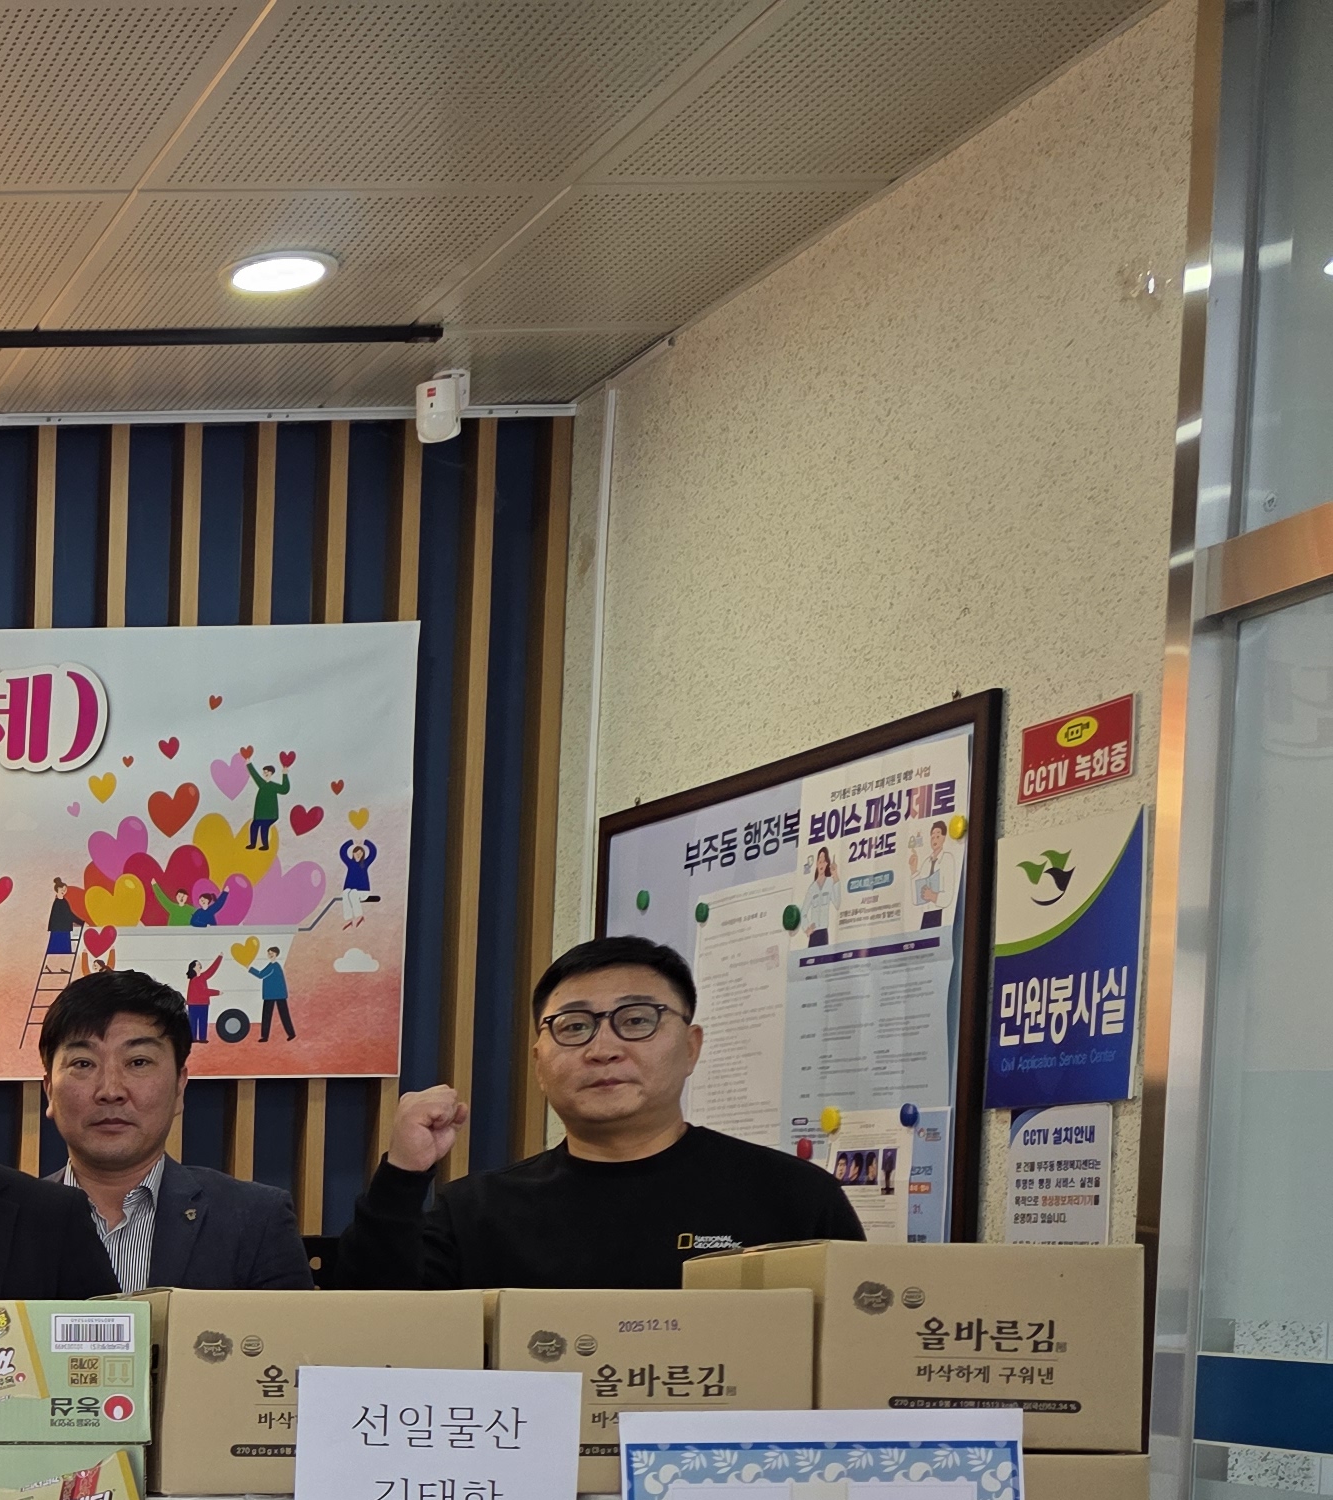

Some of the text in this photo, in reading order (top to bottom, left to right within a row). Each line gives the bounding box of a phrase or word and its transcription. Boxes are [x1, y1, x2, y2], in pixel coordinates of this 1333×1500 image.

[1023, 740, 1129, 797] CCTV 녹화중
[807, 805, 862, 846] 보이스
[863, 787, 902, 831] 피싱
[904, 778, 957, 820] 제로
[683, 827, 738, 877] 부주동
[847, 832, 897, 864] 2차년도
[999, 965, 1128, 1047] 민원봉사실
[1001, 1049, 1117, 1073] Civil Application Service Center
[1023, 1125, 1096, 1146] CCTV 설치안내
[914, 1316, 1057, 1354] 올바른김
[589, 1363, 726, 1398] 올바른김
[915, 1363, 1055, 1386] 바삭하게 구워낸
[49, 1396, 101, 1418] 농심
[351, 1403, 528, 1450] 선일물산
